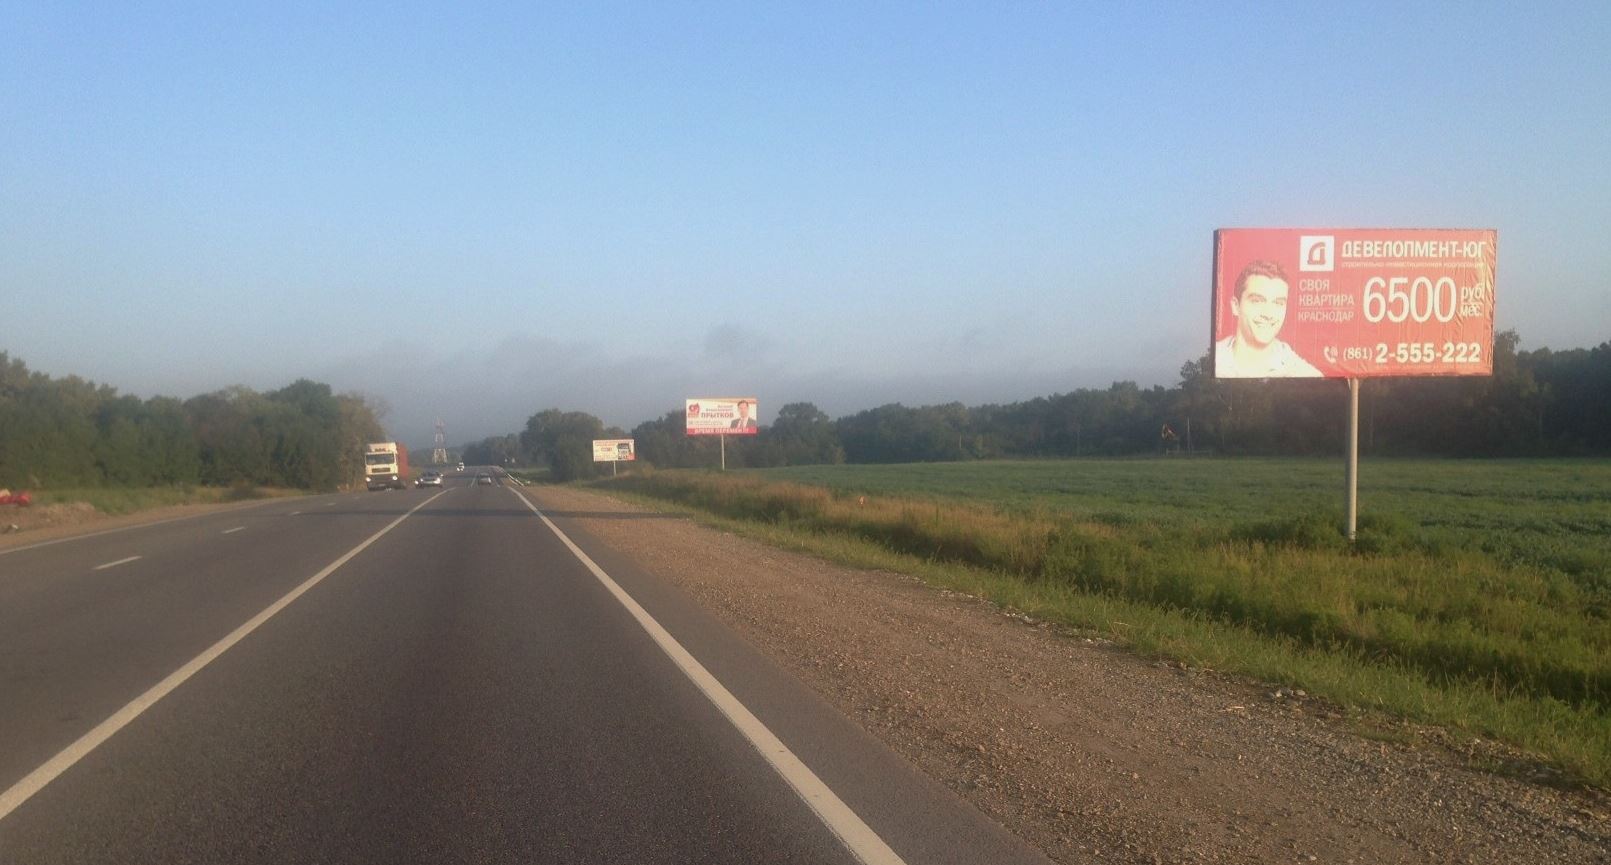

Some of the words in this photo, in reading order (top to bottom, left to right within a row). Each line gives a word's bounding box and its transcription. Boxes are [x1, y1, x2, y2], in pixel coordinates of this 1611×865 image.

[1341, 240, 1487, 258] ДЕВЕЛОПМЕНТ-ЮГ
[1298, 279, 1330, 292] СВОЯ
[1298, 294, 1355, 307] КВАРТИРА
[1363, 276, 1457, 323] 6500
[1297, 311, 1354, 323] КРАСНОДАР
[1343, 346, 1373, 361] (861)
[1375, 342, 1481, 364] 2-555-222
